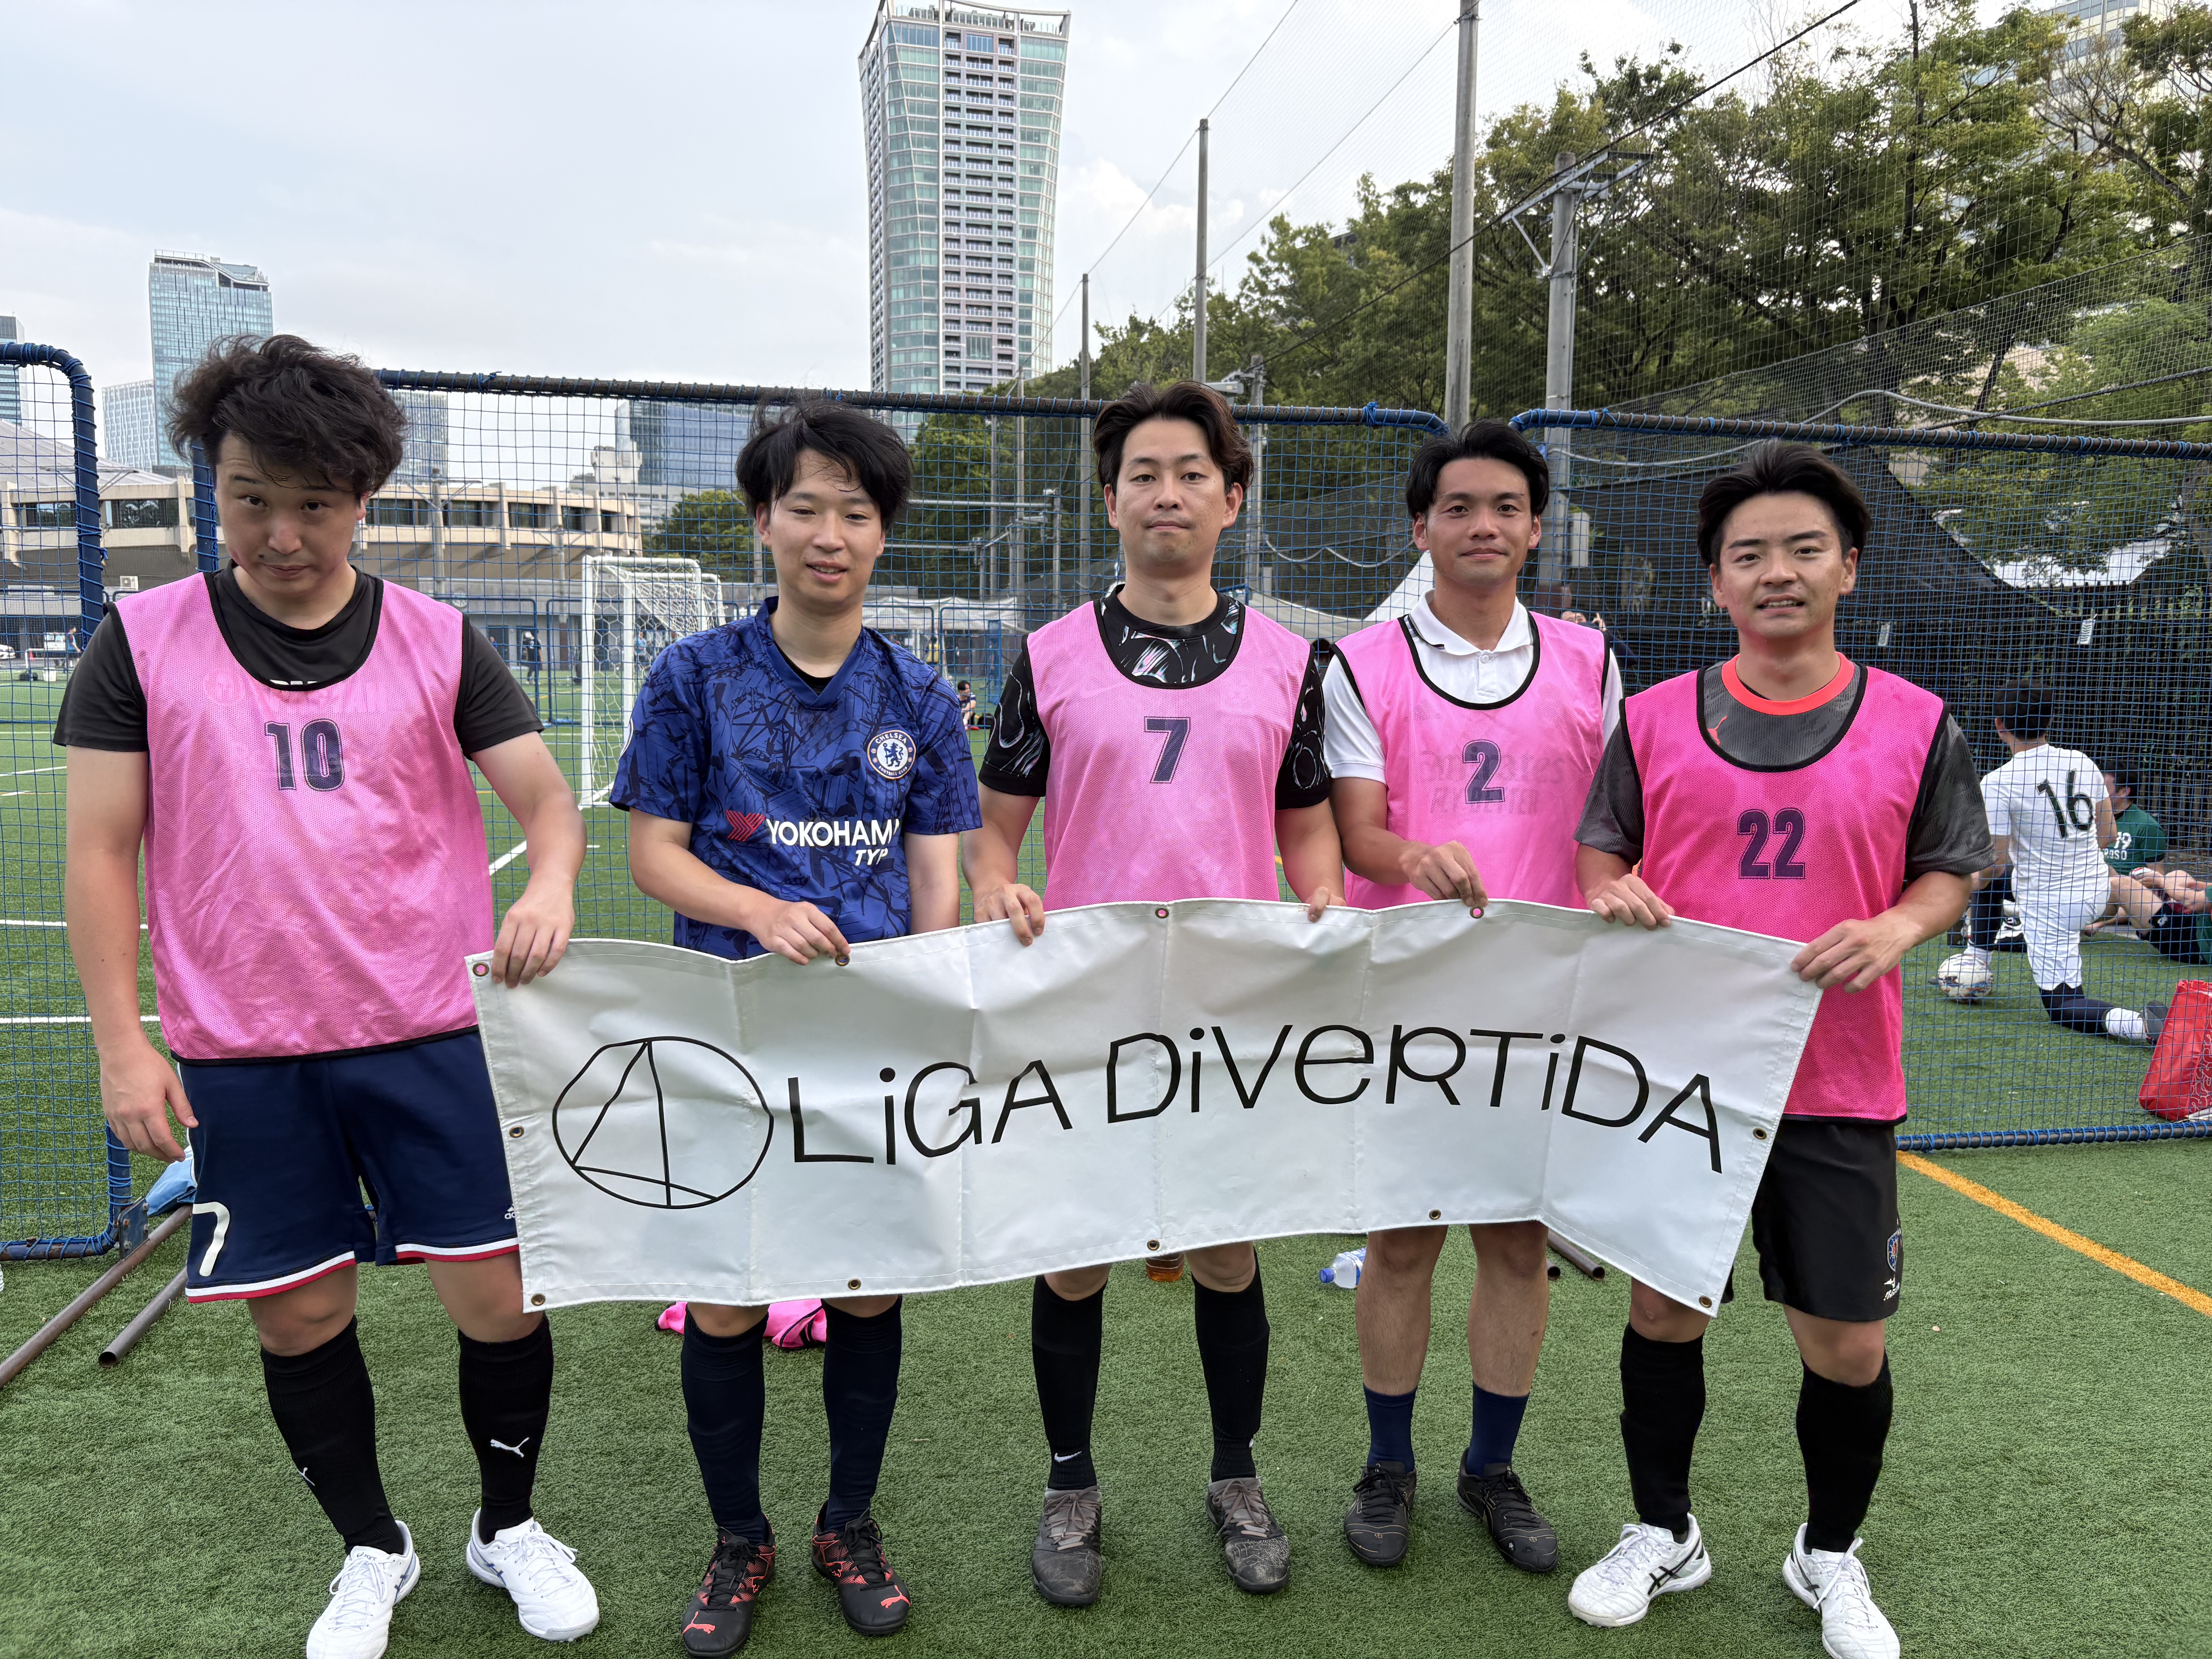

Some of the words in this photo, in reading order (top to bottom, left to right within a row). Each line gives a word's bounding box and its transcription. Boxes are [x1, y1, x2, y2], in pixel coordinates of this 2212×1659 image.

[264, 718, 346, 792] 10
[875, 732, 907, 744] CHELSEA
[878, 766, 897, 776] FOOTBALL
[1144, 716, 1191, 784] 7
[1462, 739, 1506, 804] 2
[2036, 768, 2094, 839] 16
[1737, 807, 1807, 880] 22
[191, 1201, 231, 1277] 7
